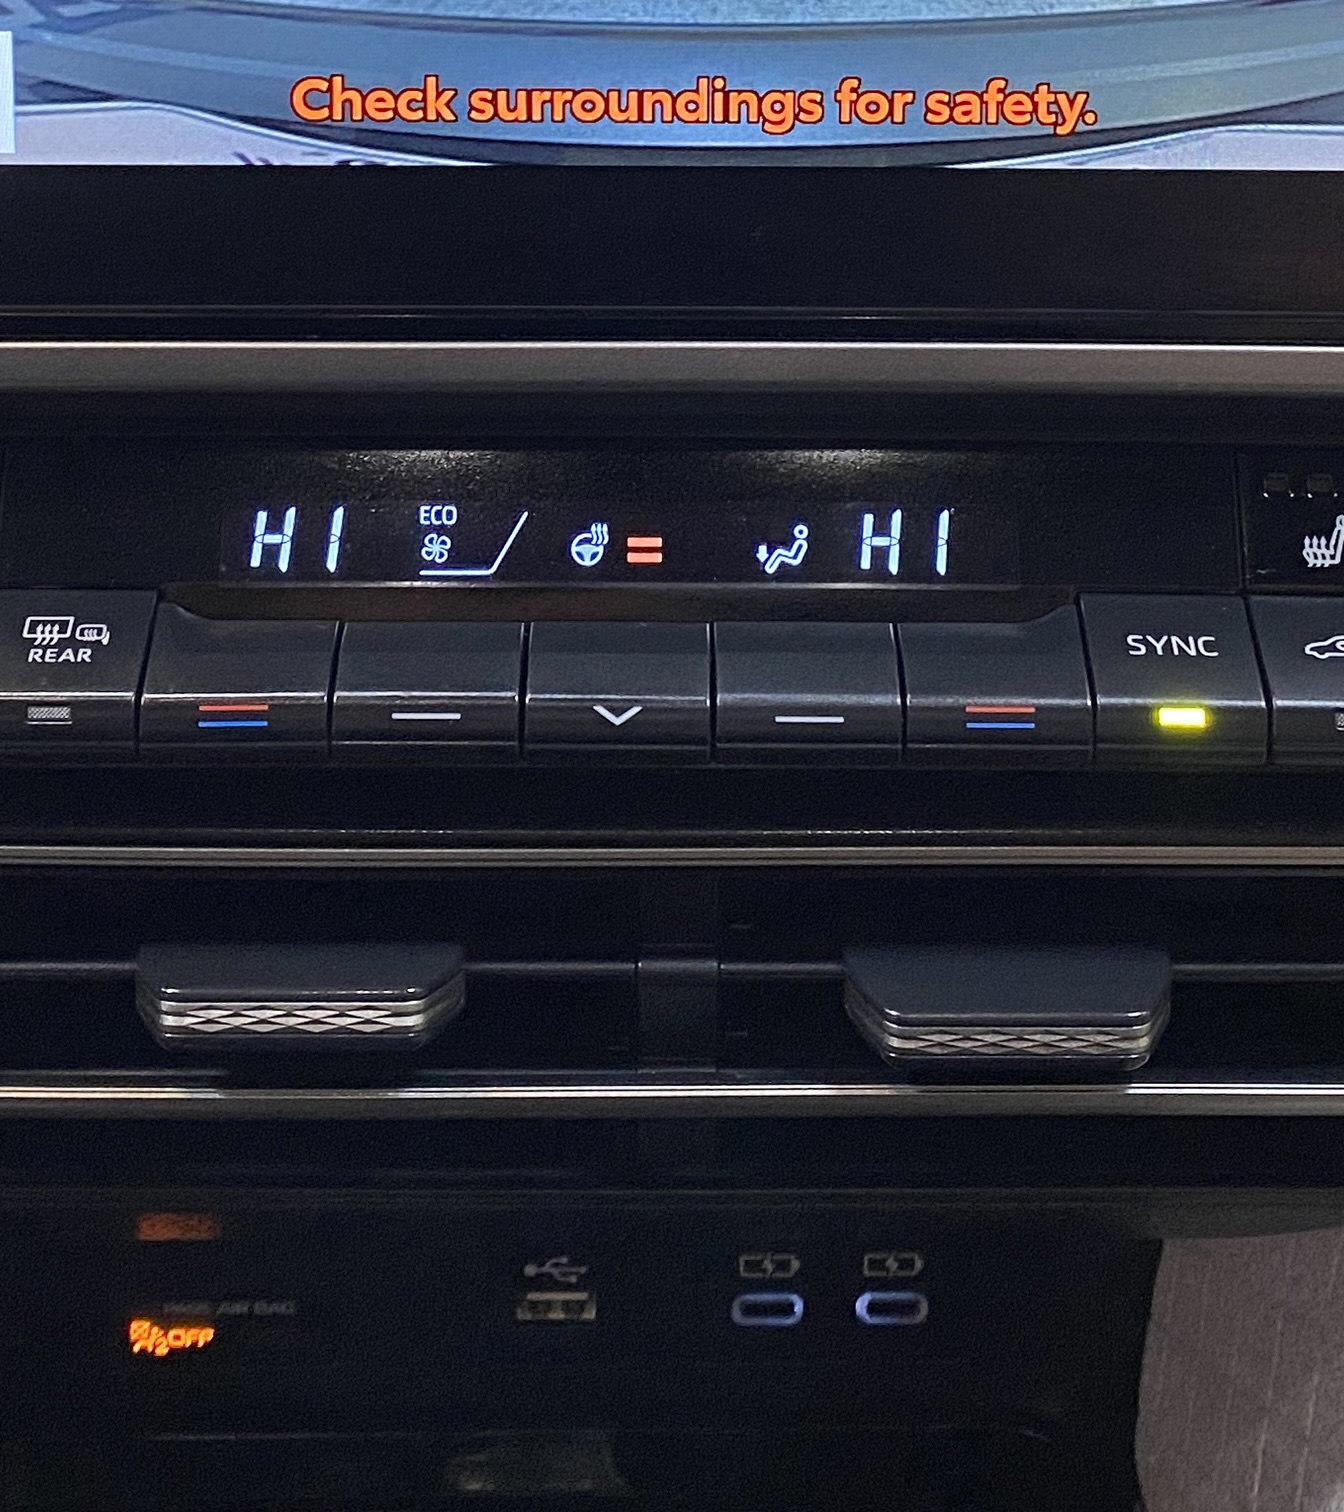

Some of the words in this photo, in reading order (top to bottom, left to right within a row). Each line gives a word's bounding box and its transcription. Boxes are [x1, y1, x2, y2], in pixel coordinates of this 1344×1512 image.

[289, 73, 459, 123] Check
[467, 74, 824, 136] surroundings
[835, 75, 916, 125] for
[924, 77, 1099, 136] safety.
[418, 504, 458, 527] ECO
[248, 505, 345, 574] HI
[859, 507, 951, 576] HI
[26, 647, 93, 664] REAR
[1126, 633, 1220, 659] SYNC
